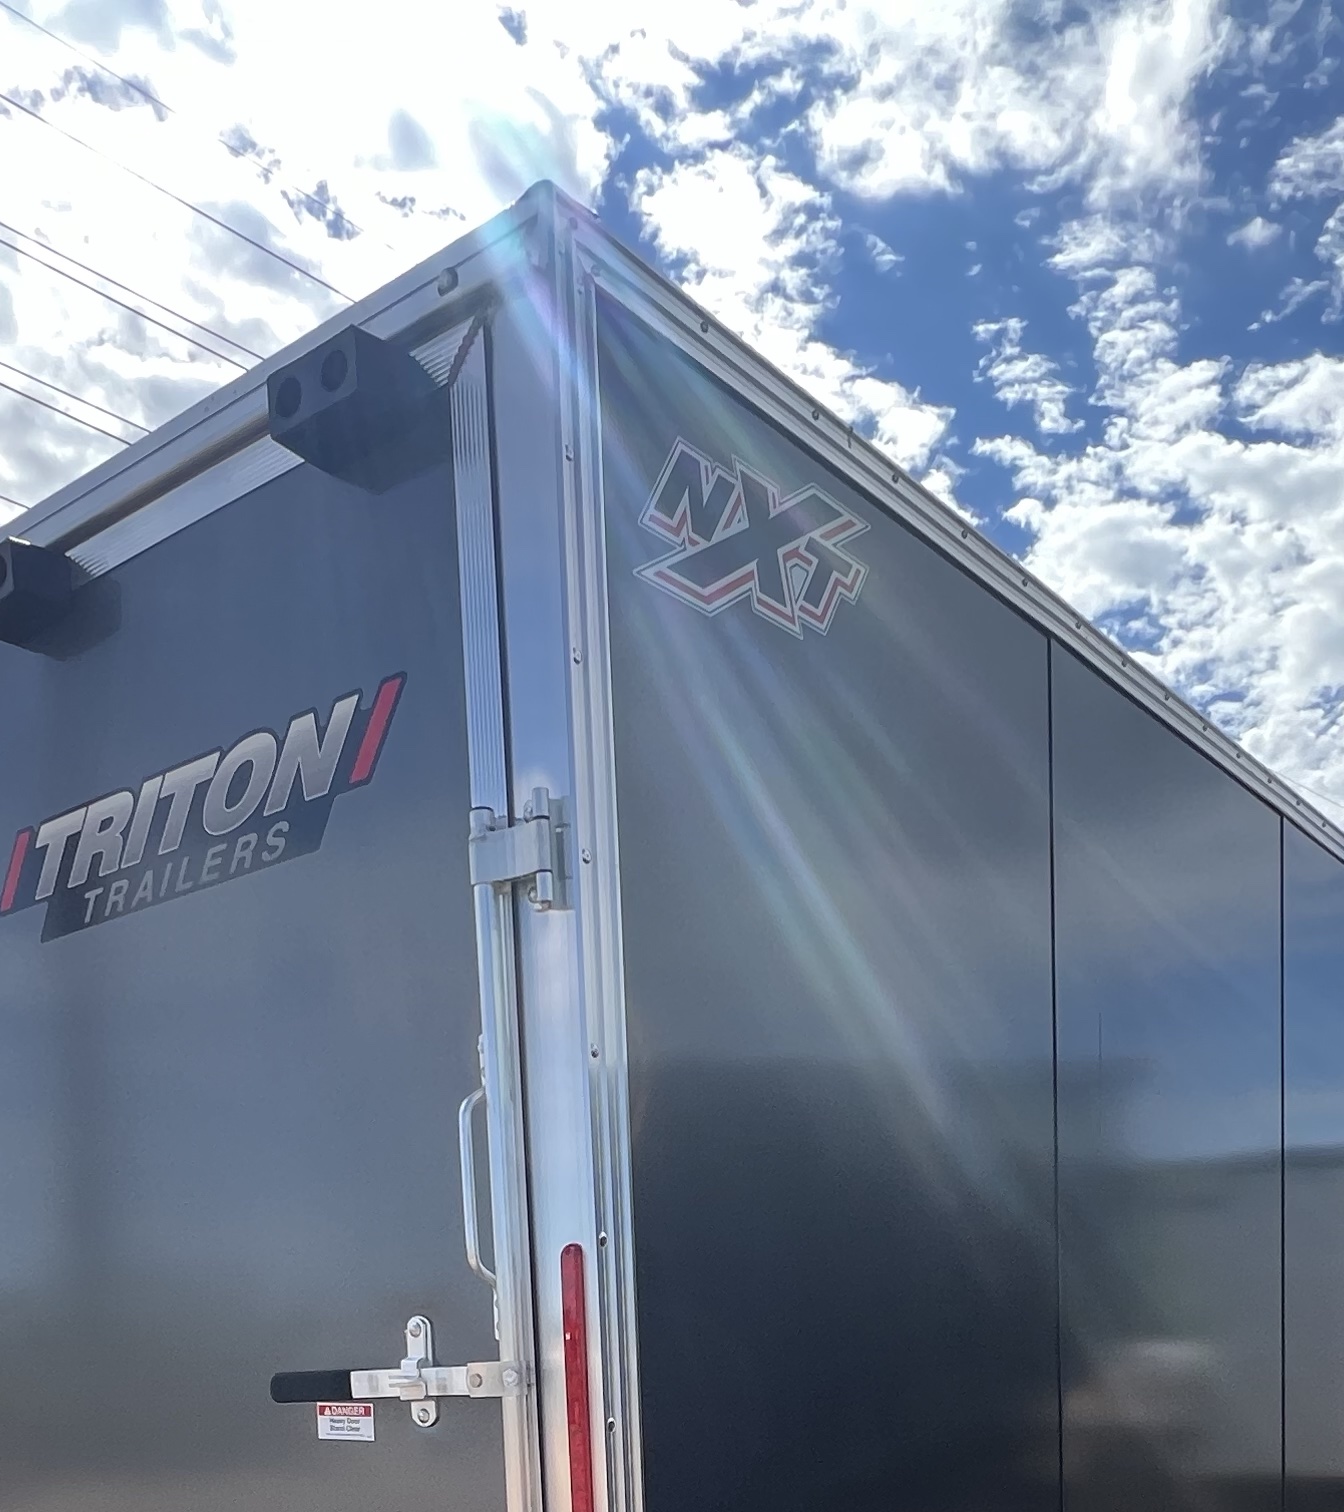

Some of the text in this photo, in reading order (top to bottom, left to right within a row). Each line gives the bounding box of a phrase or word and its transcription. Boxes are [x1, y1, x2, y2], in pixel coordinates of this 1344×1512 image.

[635, 438, 870, 638] NXT
[35, 692, 359, 901] TRITON
[83, 820, 290, 924] TRAILERS
[331, 1406, 365, 1416] DANGER
